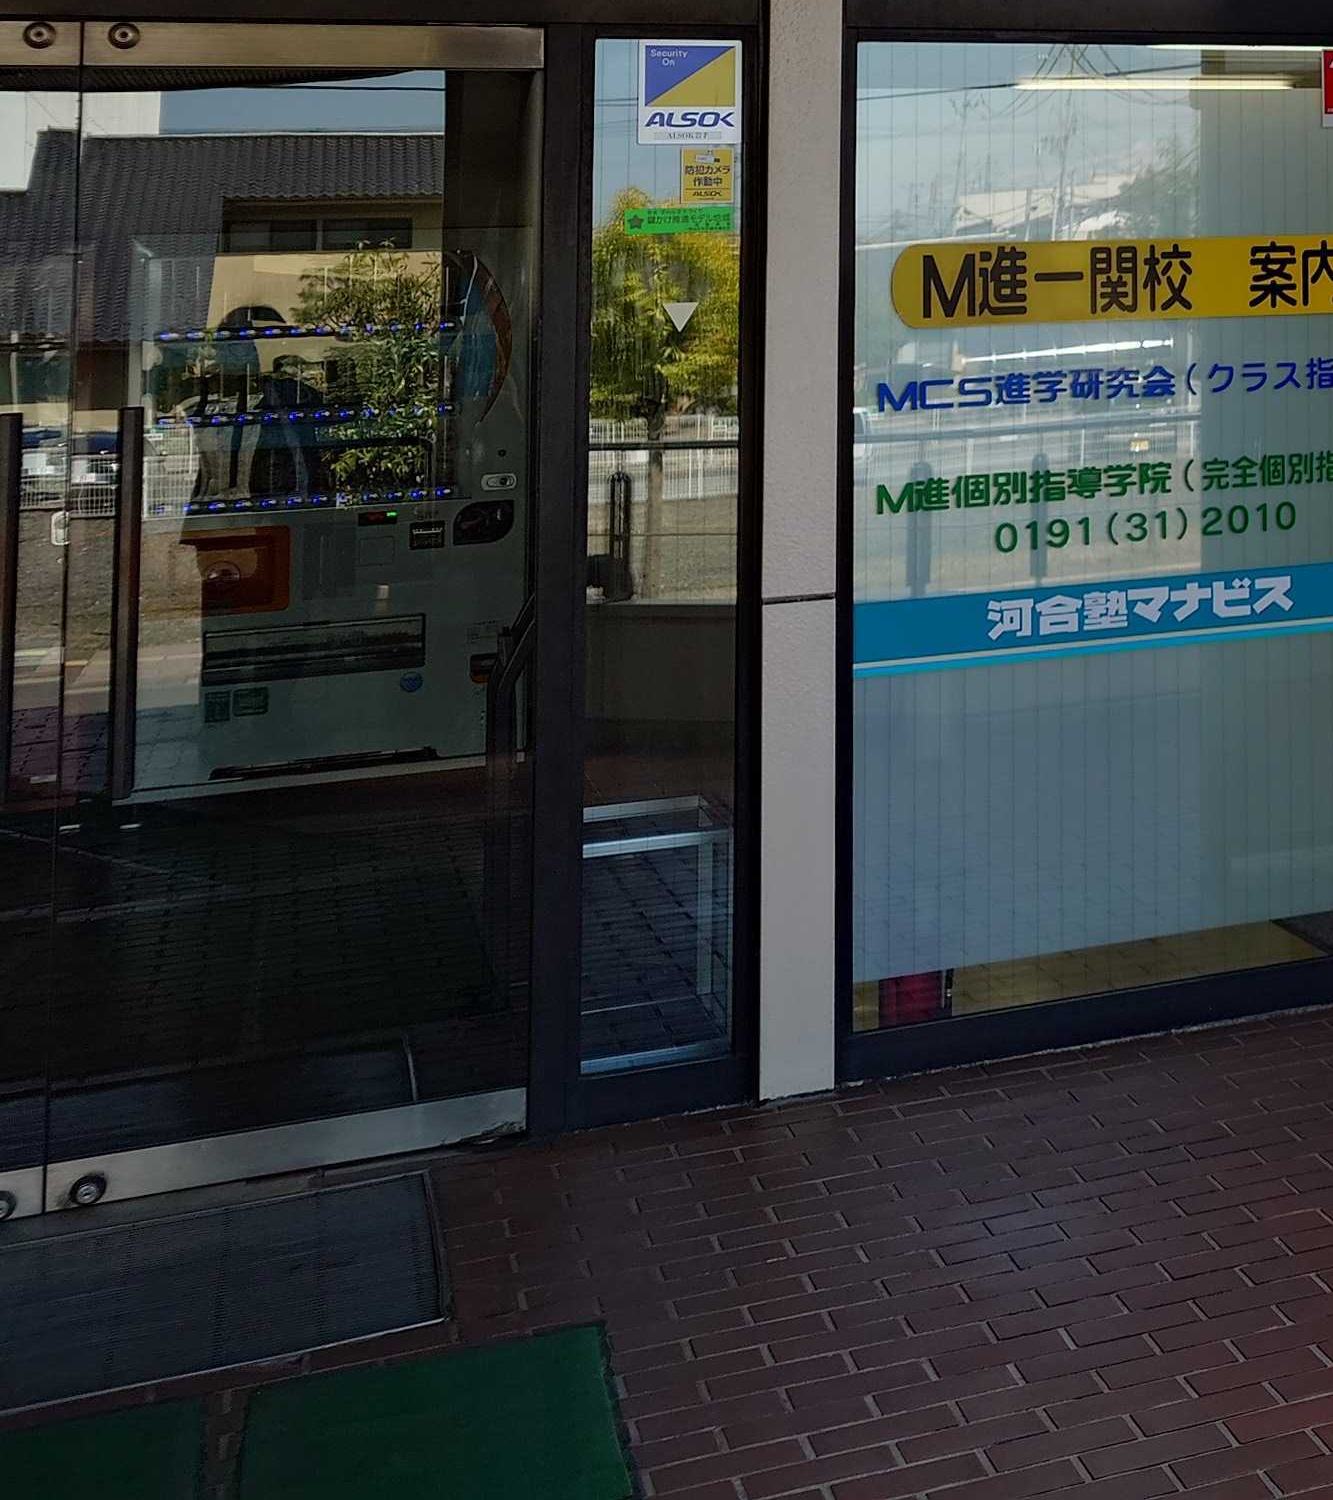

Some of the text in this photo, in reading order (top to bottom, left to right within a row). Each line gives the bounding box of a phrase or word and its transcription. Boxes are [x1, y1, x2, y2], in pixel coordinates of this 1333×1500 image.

[650, 49, 688, 58] Security
[662, 58, 675, 66] On
[645, 112, 735, 127] ALSOK
[921, 243, 1194, 319] M進一関校
[987, 575, 1294, 641] 河合塾マナビス
